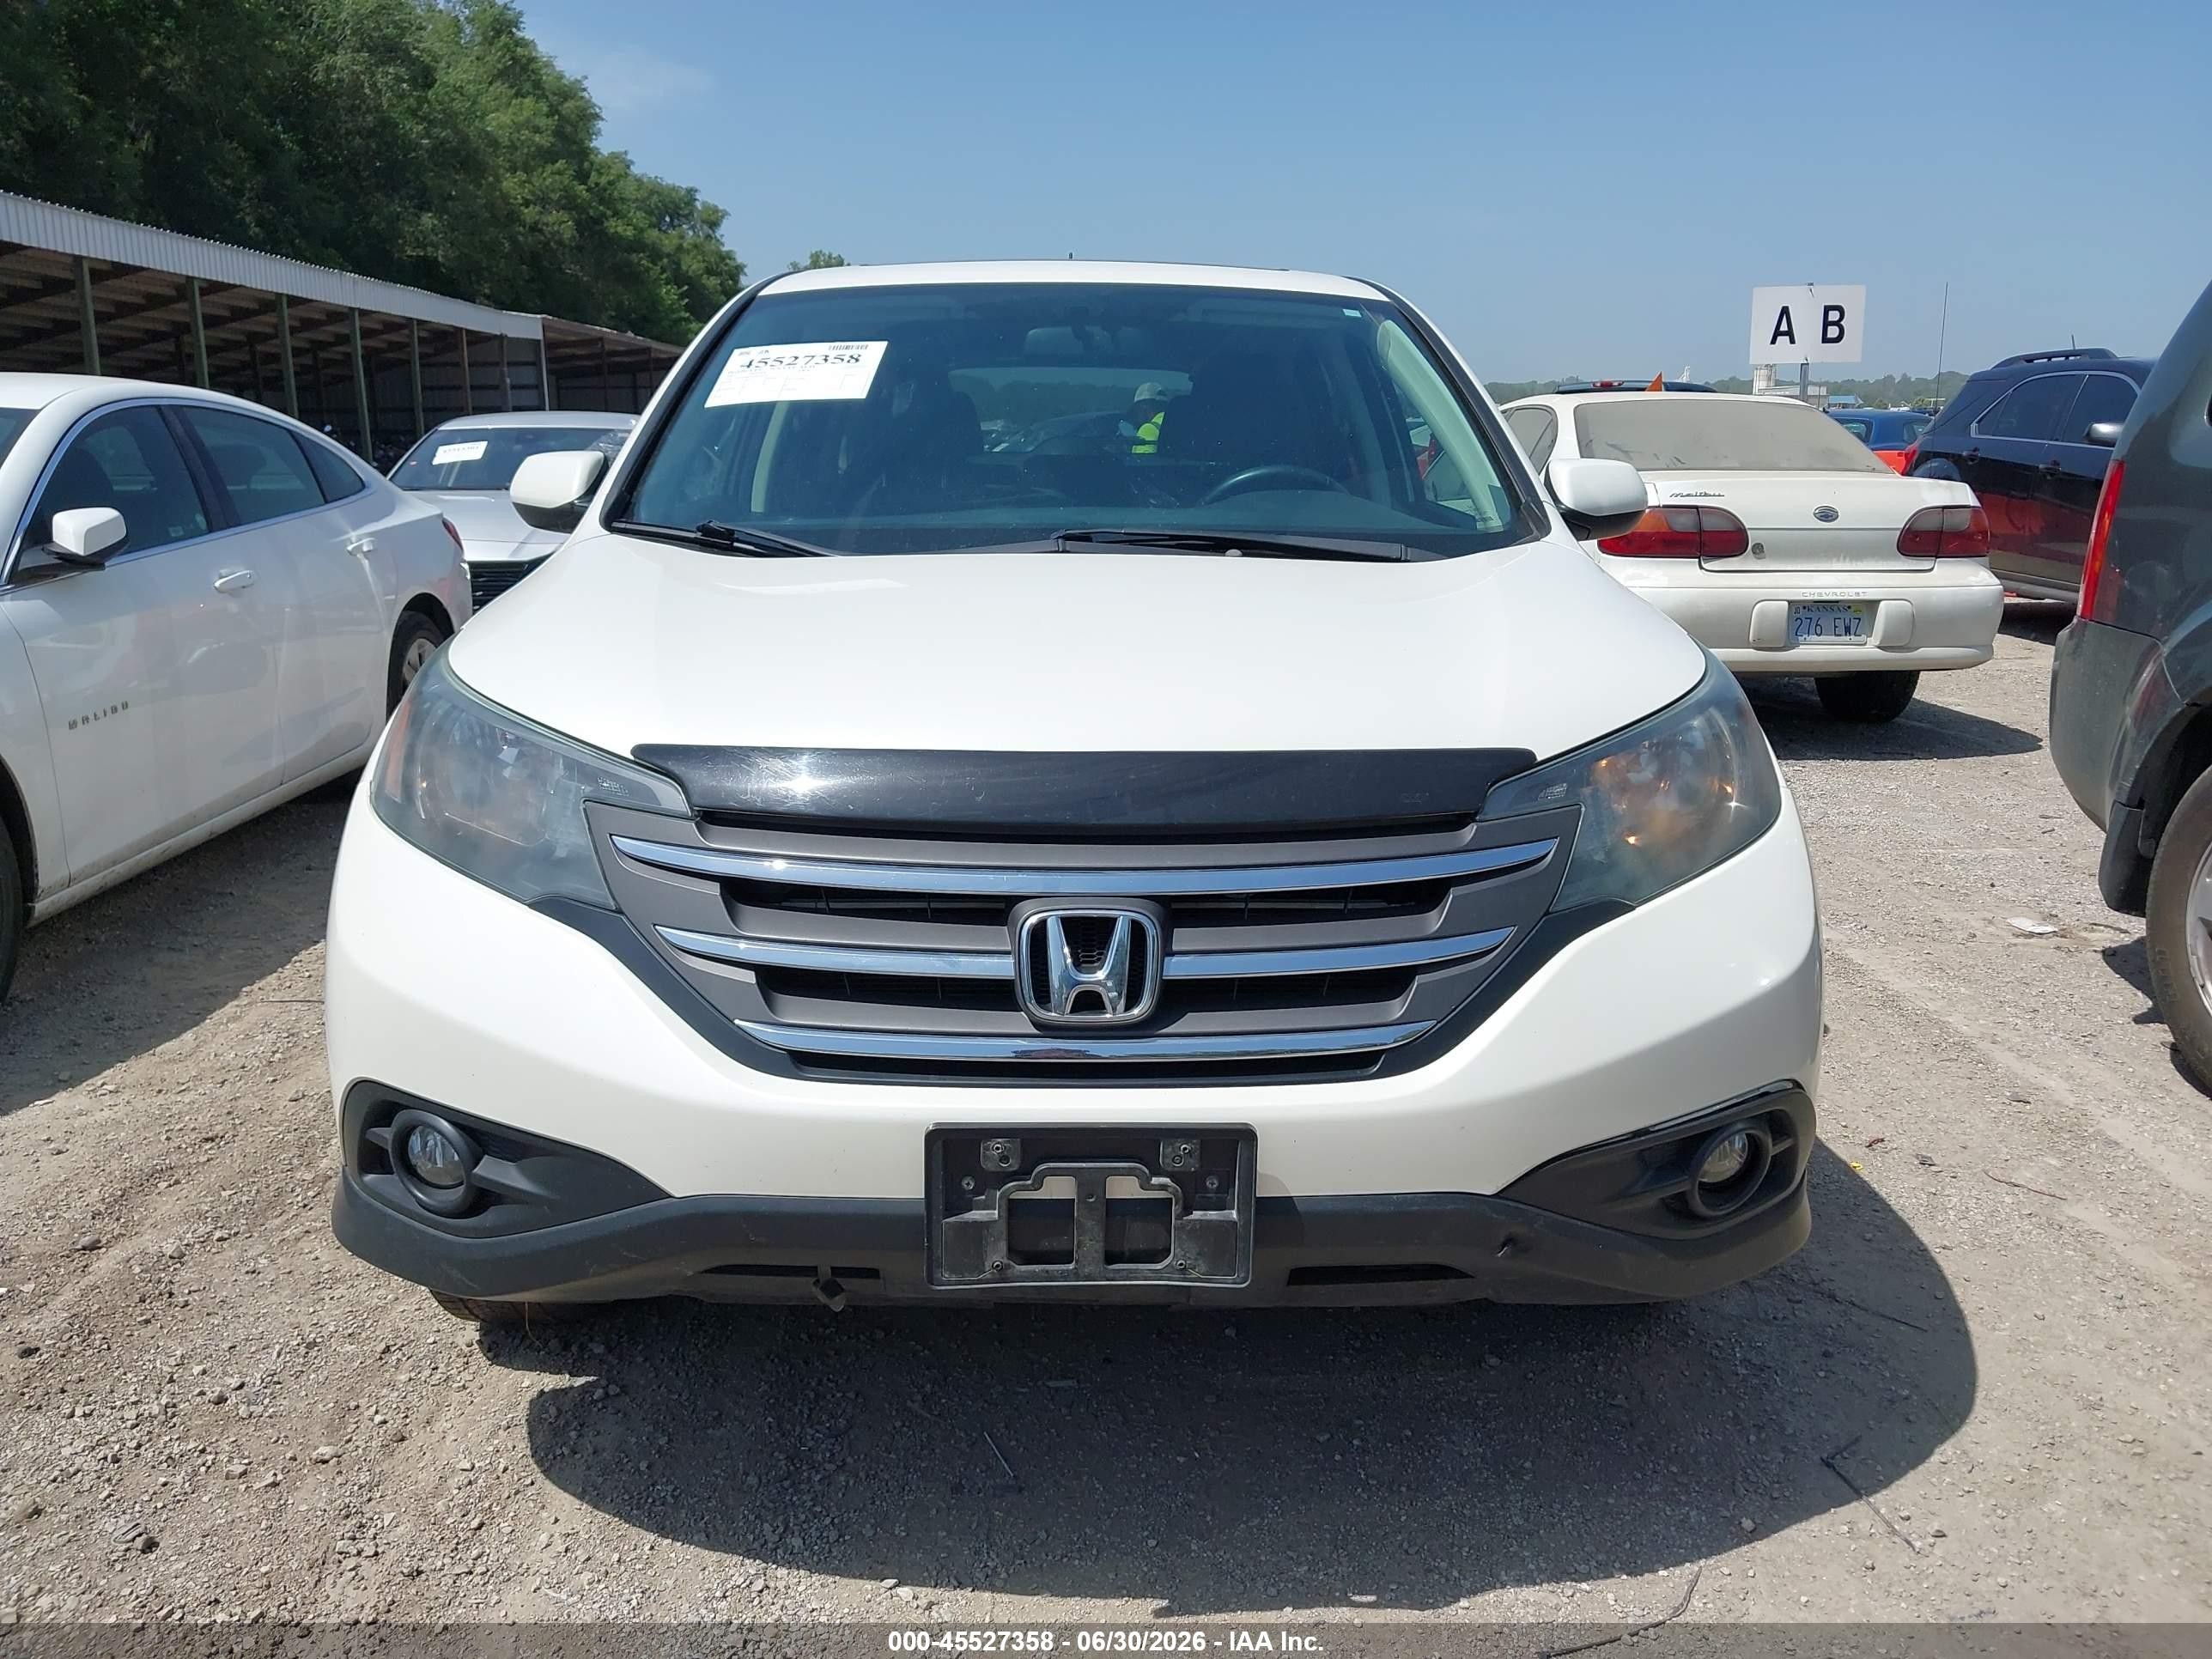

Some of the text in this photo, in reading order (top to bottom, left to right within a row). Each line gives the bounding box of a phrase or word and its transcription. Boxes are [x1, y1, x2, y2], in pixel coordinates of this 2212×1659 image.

[1770, 304, 1845, 345] A B
[740, 353, 862, 368] 45527358
[1795, 617, 1863, 637] 276 EWZ
[69, 701, 129, 730] MALIBU
